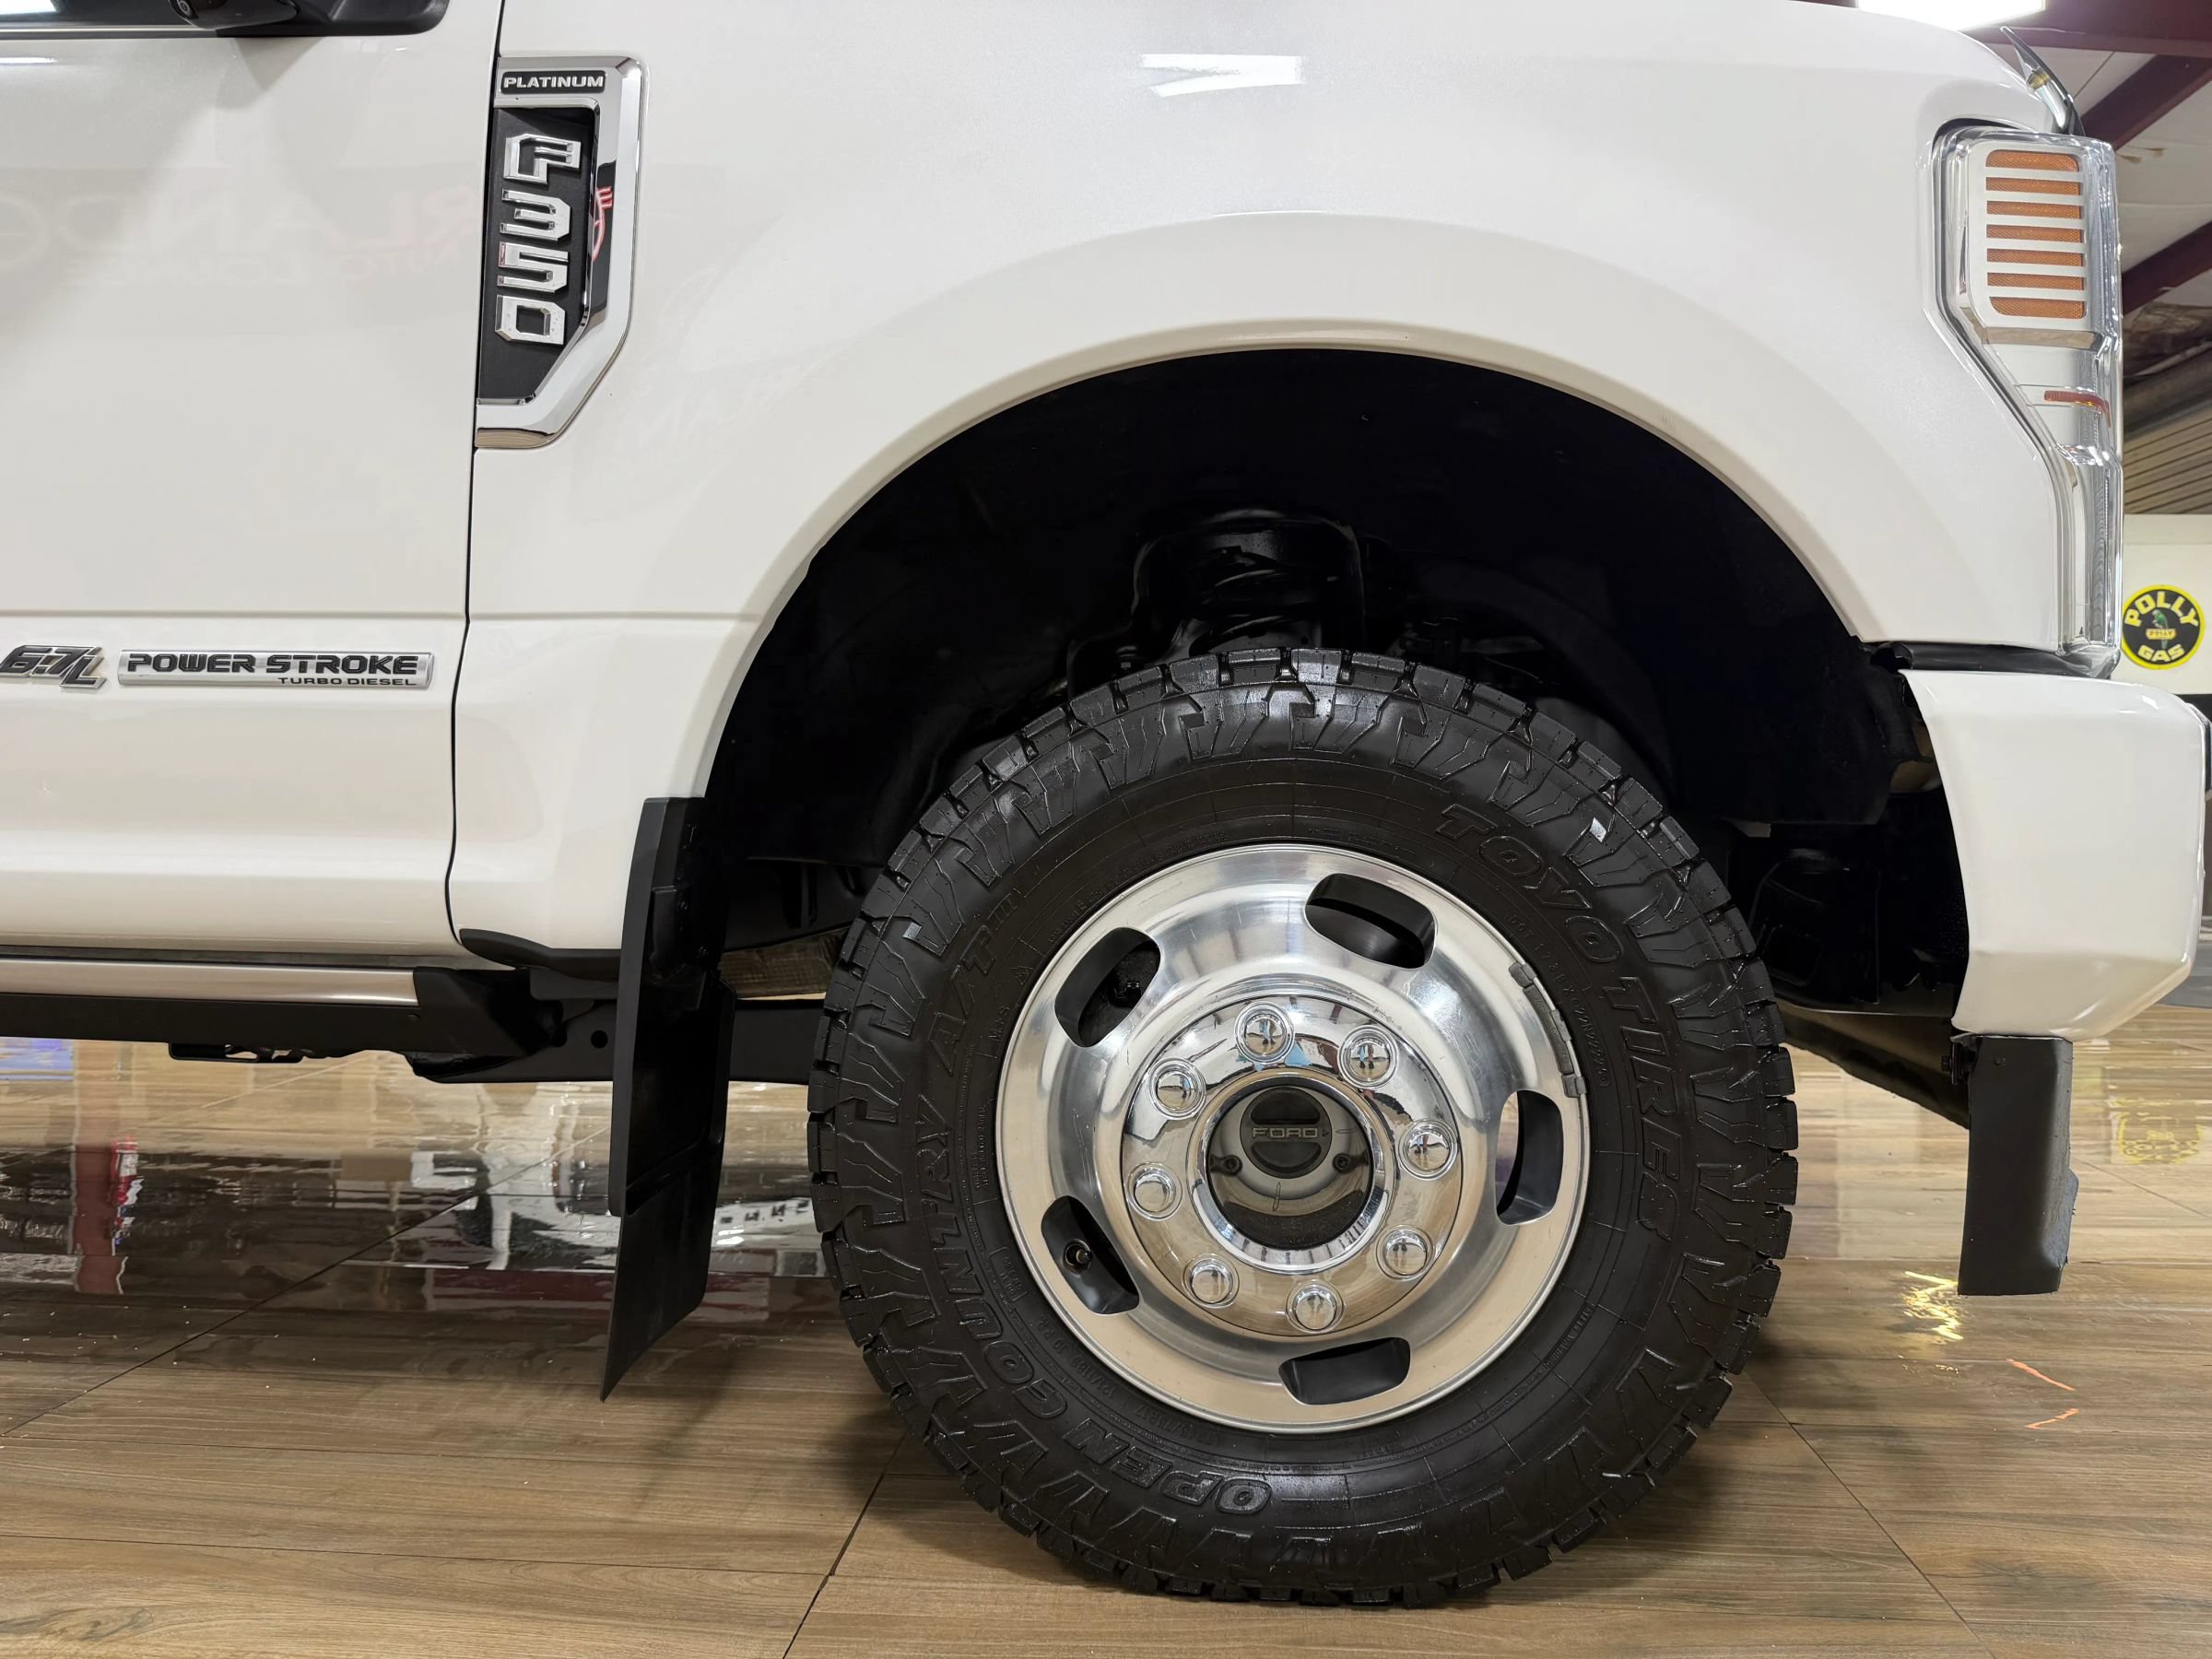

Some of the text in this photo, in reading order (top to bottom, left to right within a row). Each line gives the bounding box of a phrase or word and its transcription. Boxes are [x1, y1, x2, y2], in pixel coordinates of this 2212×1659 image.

[503, 75, 605, 88] PLATINUM
[494, 133, 582, 346] F350
[2124, 591, 2199, 627] POLLY
[127, 653, 418, 675] POWER STROKE
[2137, 644, 2185, 662] GAS
[278, 677, 418, 686] TURBO DIESEL
[1436, 804, 1681, 1242] TOYO TIRES
[1252, 1126, 1319, 1140] FORD
[915, 1094, 1068, 1420] COUNTRY
[1062, 1418, 1272, 1515] OPEN
